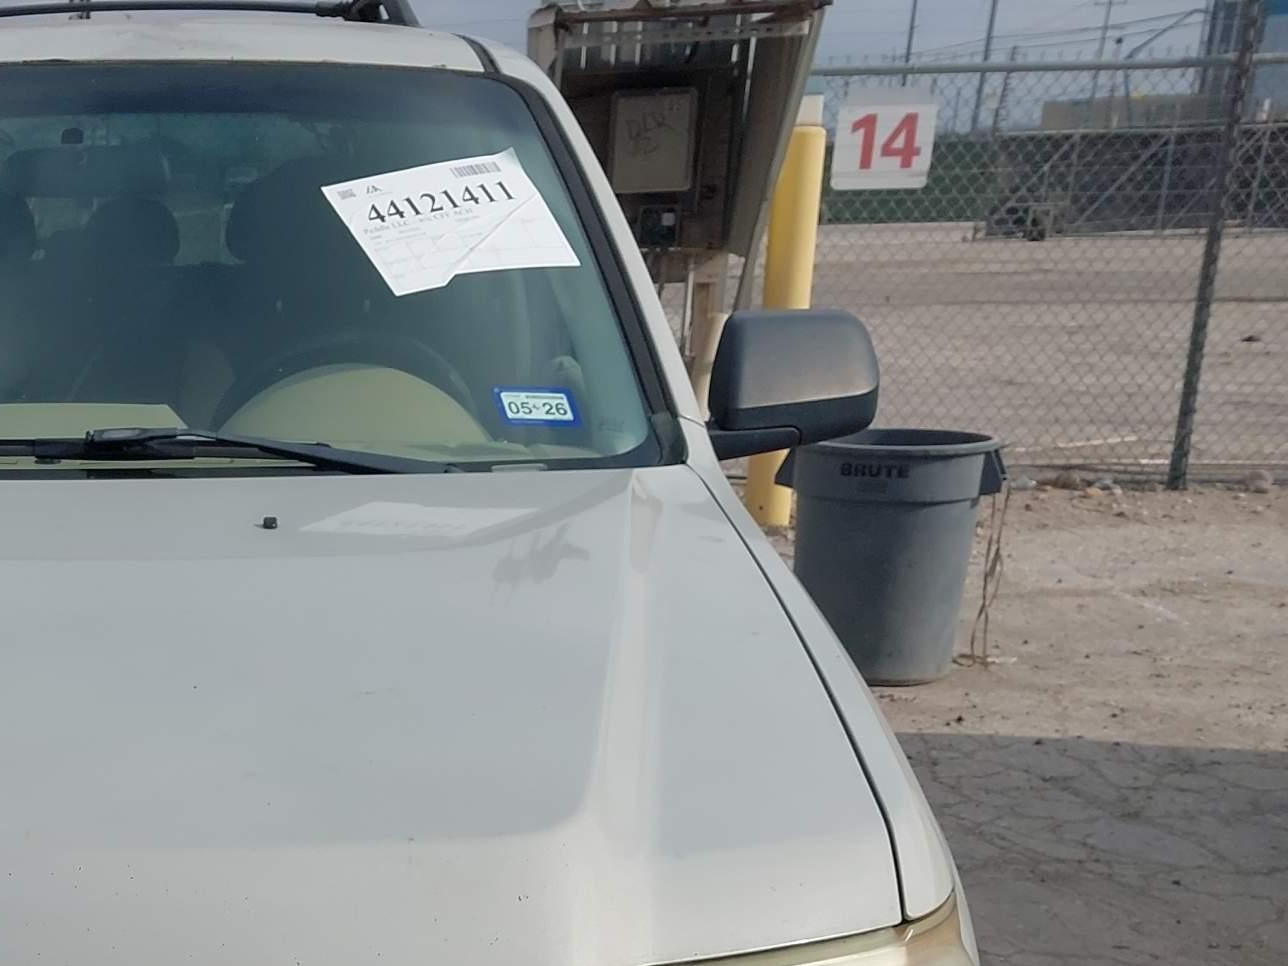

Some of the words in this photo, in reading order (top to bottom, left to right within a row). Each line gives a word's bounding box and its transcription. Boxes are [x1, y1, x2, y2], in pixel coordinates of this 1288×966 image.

[850, 112, 921, 170] 14
[367, 180, 515, 223] 44121411
[507, 401, 533, 415] 05
[542, 402, 568, 416] 26
[840, 462, 911, 479] BRUTE
